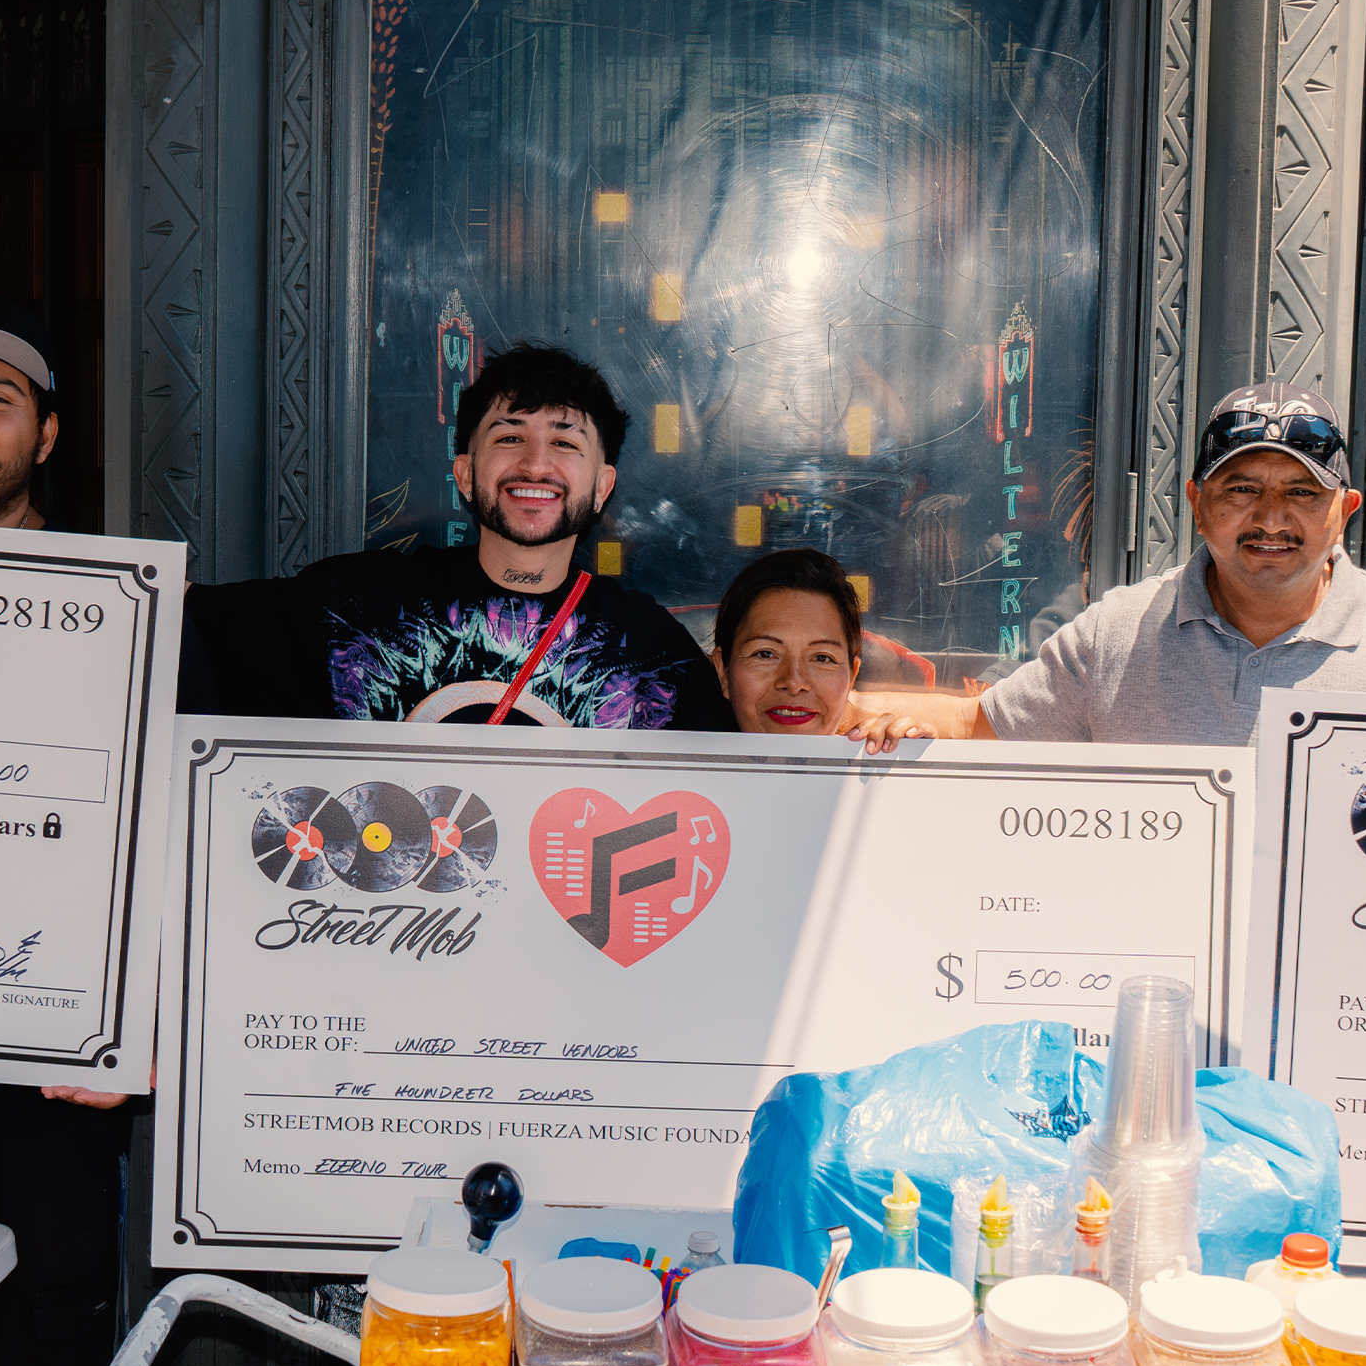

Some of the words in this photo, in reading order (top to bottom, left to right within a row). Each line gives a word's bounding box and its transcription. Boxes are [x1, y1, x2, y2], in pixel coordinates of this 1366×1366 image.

[999, 806, 1184, 841] 00028189
[979, 896, 1041, 913] DATE:
[255, 899, 393, 950] Street
[388, 911, 482, 962] Mob
[935, 953, 964, 1002] $
[1, 992, 80, 1011] SIGNATURE
[245, 1013, 284, 1029] PAY
[290, 1015, 318, 1031] TO
[324, 1016, 366, 1032] THE
[244, 1034, 318, 1052] ORDER
[324, 1036, 358, 1052] OF:
[395, 1037, 455, 1053] UNITED
[474, 1038, 547, 1056] STREET
[561, 1043, 638, 1059] VENDORS
[335, 1082, 376, 1096] FIVE
[244, 1113, 374, 1132] STREETMOB
[381, 1118, 482, 1136] RECORDS
[498, 1121, 583, 1140] FUERZA
[588, 1124, 658, 1142] MUSIC
[243, 1158, 300, 1175] Memo
[402, 1161, 448, 1178] TOUR
